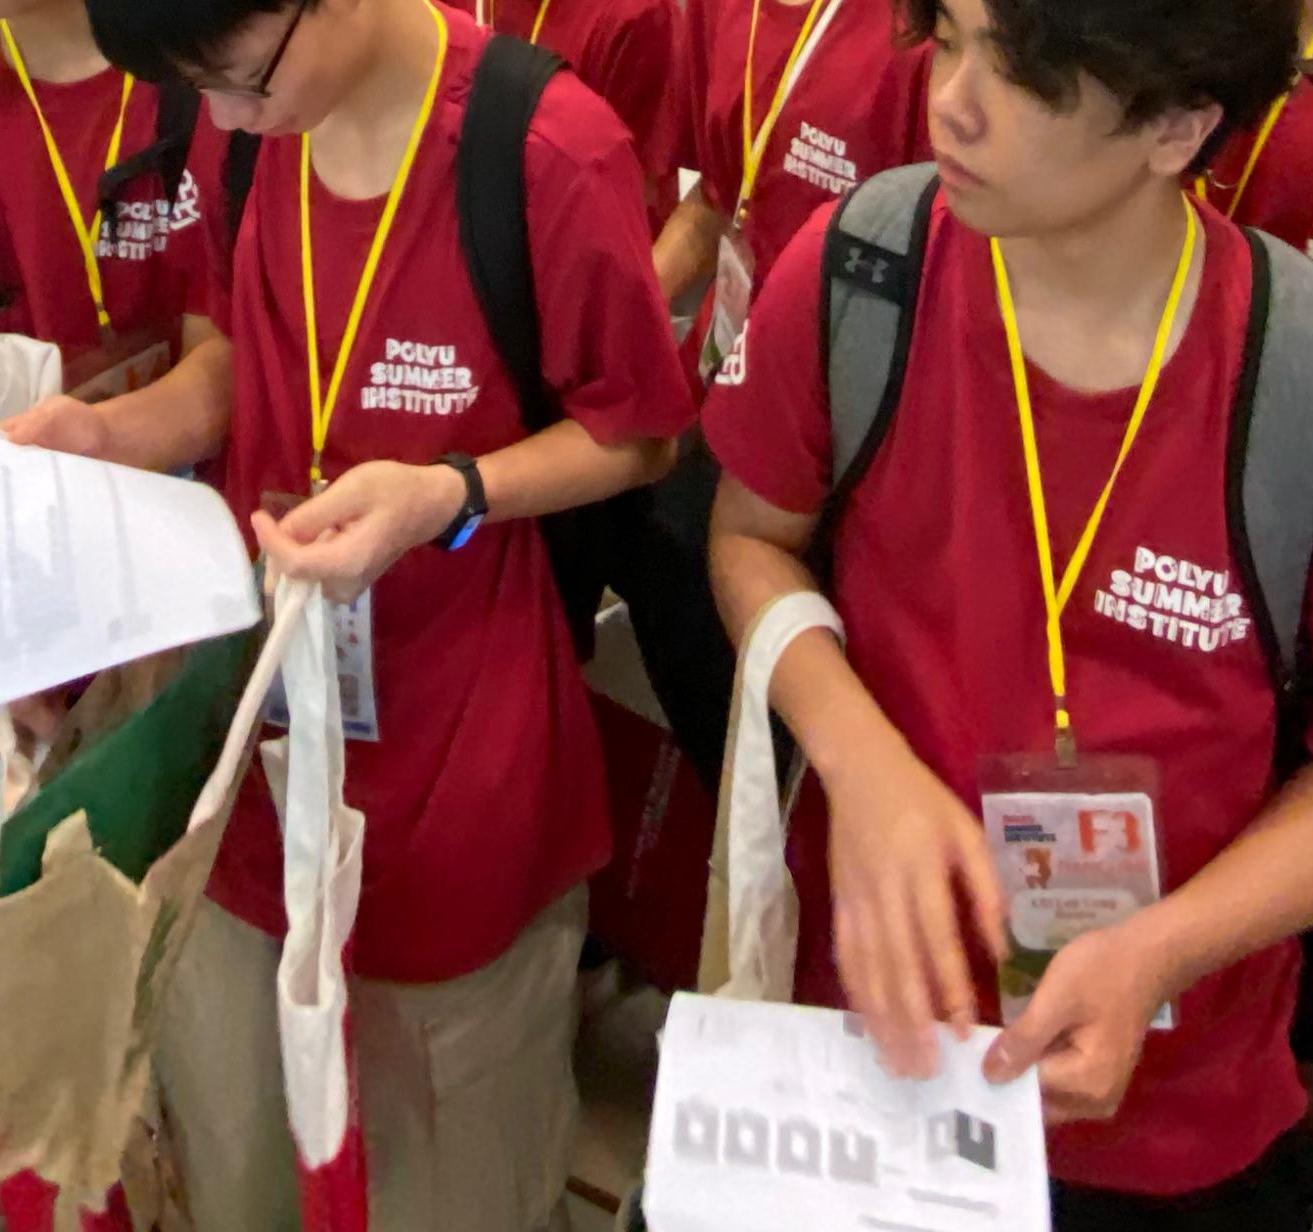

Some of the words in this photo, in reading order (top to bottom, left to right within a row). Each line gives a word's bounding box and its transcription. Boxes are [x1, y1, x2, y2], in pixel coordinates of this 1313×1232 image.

[370, 361, 473, 389] SUMMER
[385, 337, 456, 367] POLYU
[1134, 546, 1230, 596] POLYU
[1093, 588, 1252, 652] INSTITUTE
[1109, 569, 1243, 624] SUMMER
